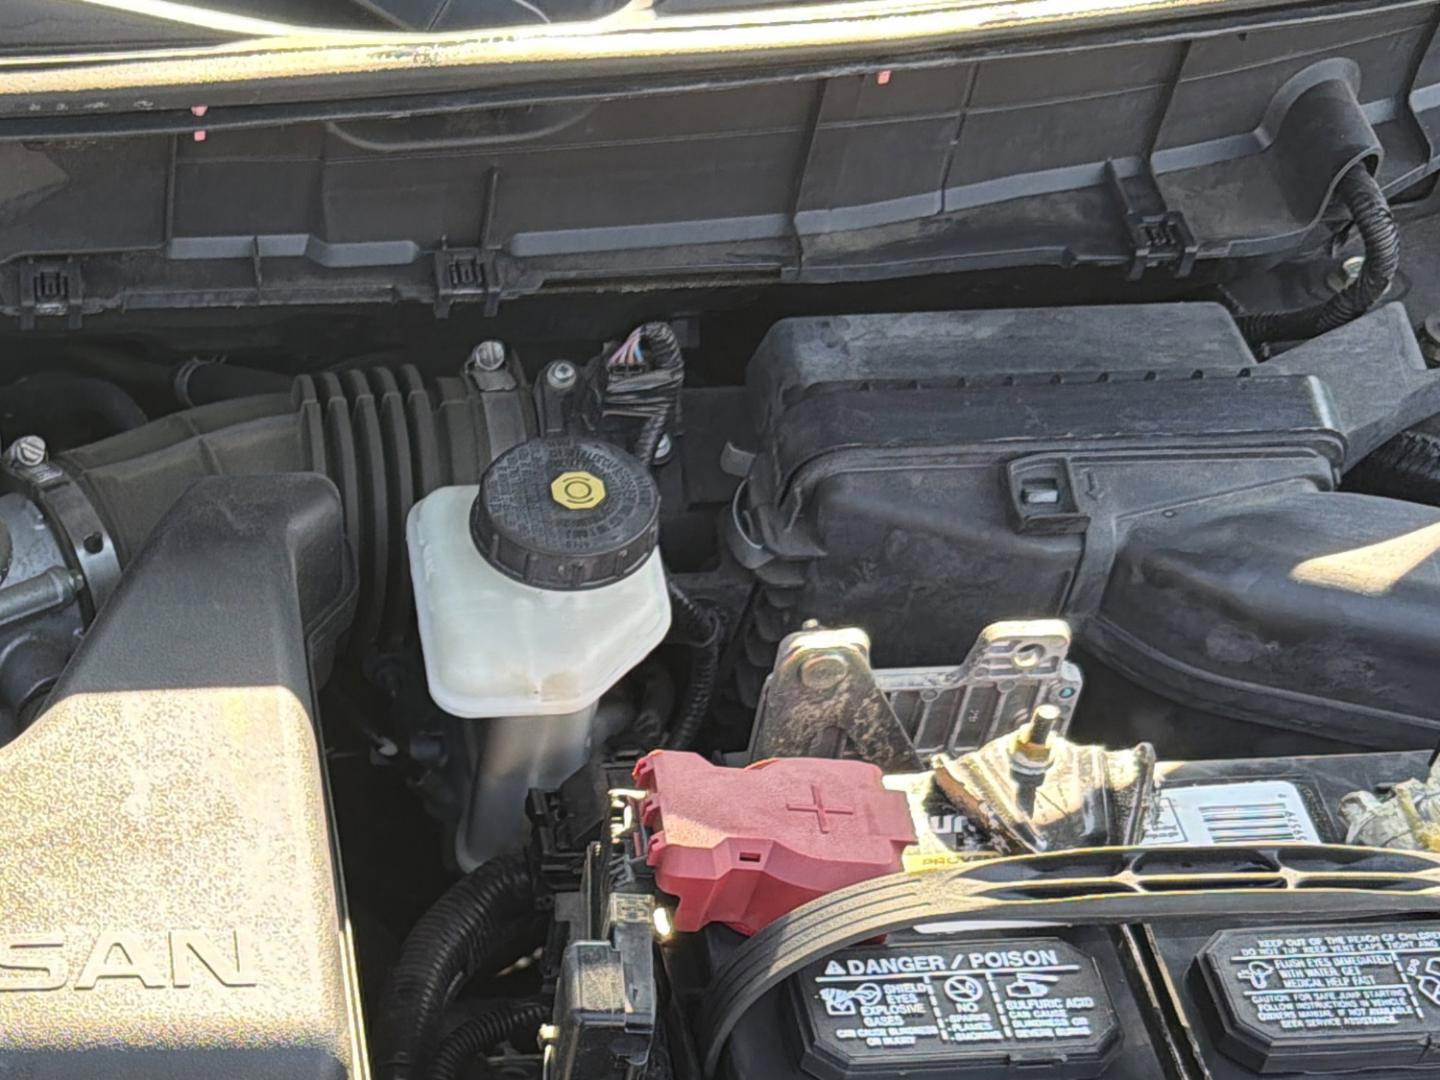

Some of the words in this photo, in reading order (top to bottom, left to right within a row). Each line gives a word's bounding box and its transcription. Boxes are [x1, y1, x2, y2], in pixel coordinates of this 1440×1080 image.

[847, 955, 946, 975] DANGER
[968, 950, 1058, 969] POISON
[1306, 958, 1333, 967] EYES
[883, 983, 927, 995] SHIELD
[886, 993, 918, 1005] EYES
[1065, 997, 1095, 1009] ACID
[860, 1003, 926, 1017] EXPLOSIVE
[956, 1002, 978, 1013] NO
